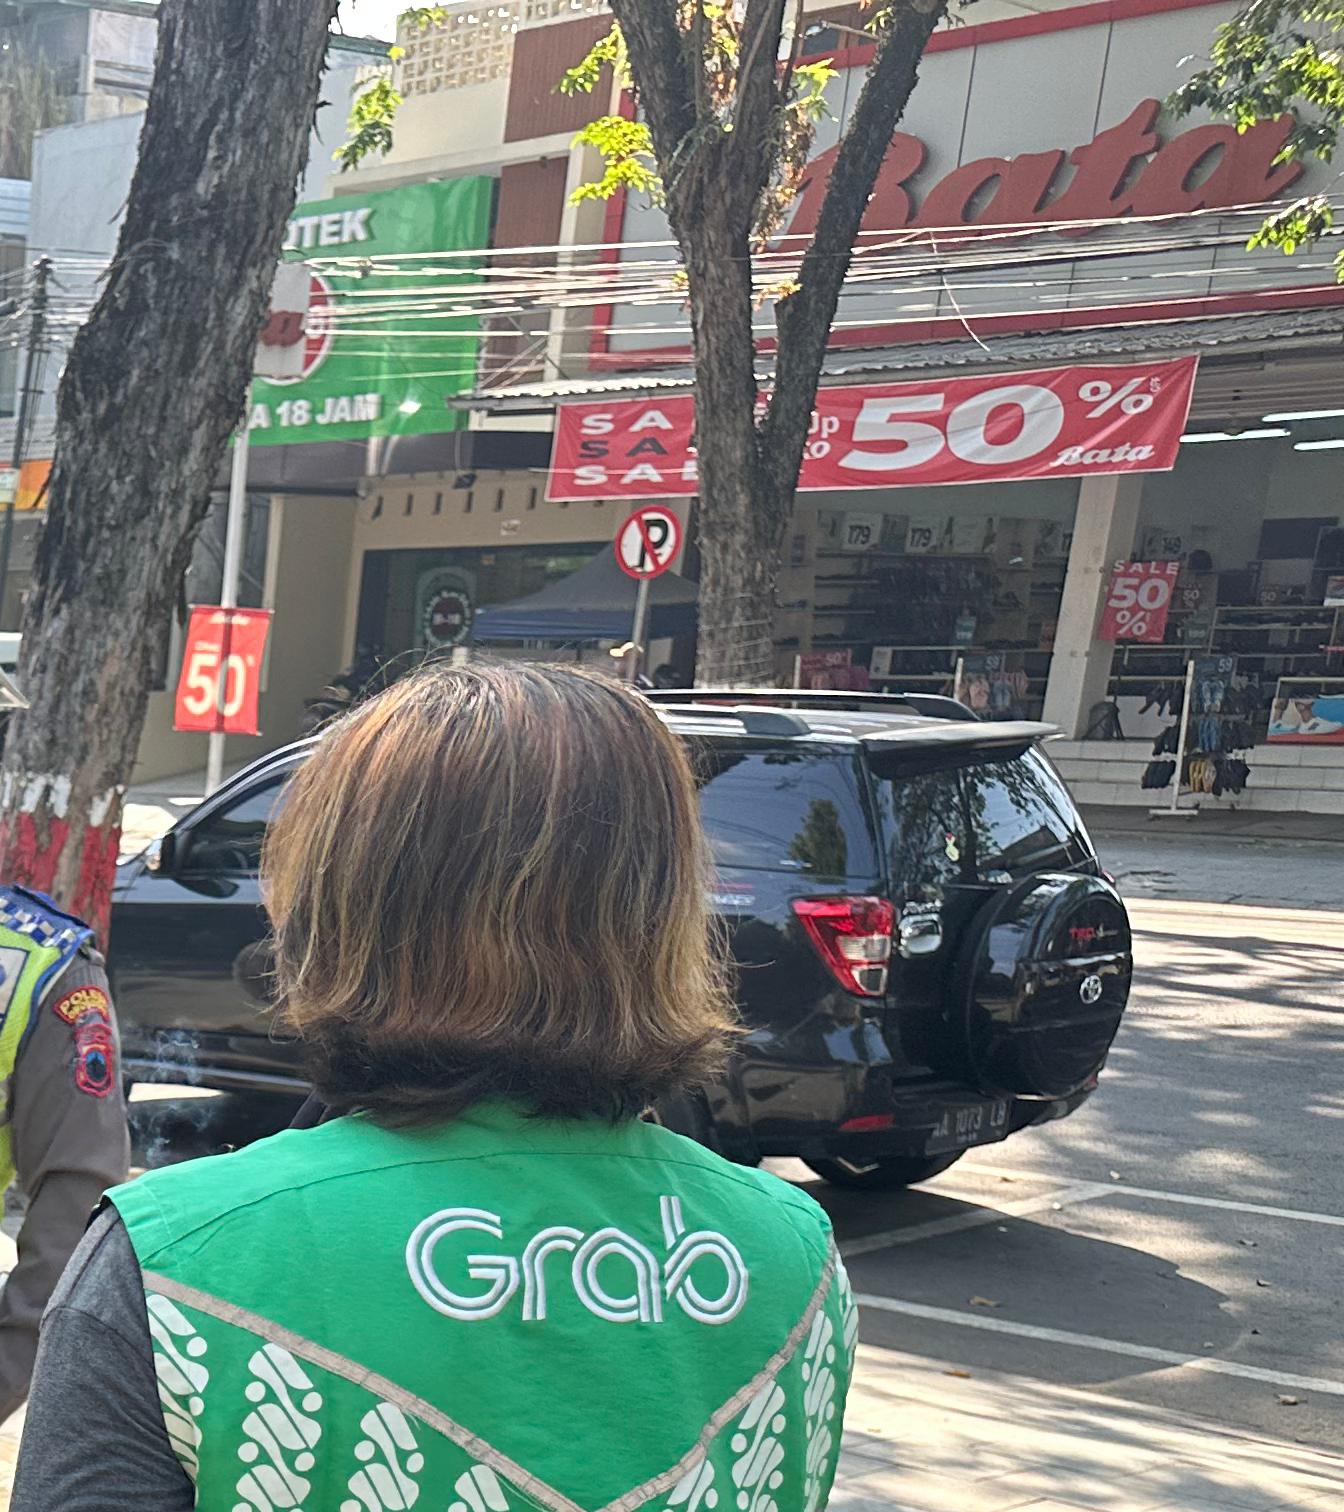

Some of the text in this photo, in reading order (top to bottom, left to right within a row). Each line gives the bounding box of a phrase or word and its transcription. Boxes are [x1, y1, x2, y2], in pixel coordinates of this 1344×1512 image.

[778, 98, 1305, 254] Bata
[276, 399, 310, 427] 18
[316, 393, 381, 423] JAM
[580, 410, 673, 435] SA
[577, 437, 669, 458] SA
[1049, 442, 1155, 468] Bata
[573, 461, 697, 486] SAL
[847, 524, 871, 545] 179
[1113, 559, 1181, 575] SALE
[1108, 577, 1169, 610] 50
[183, 653, 247, 717] 50
[405, 1195, 748, 1325] Grab
